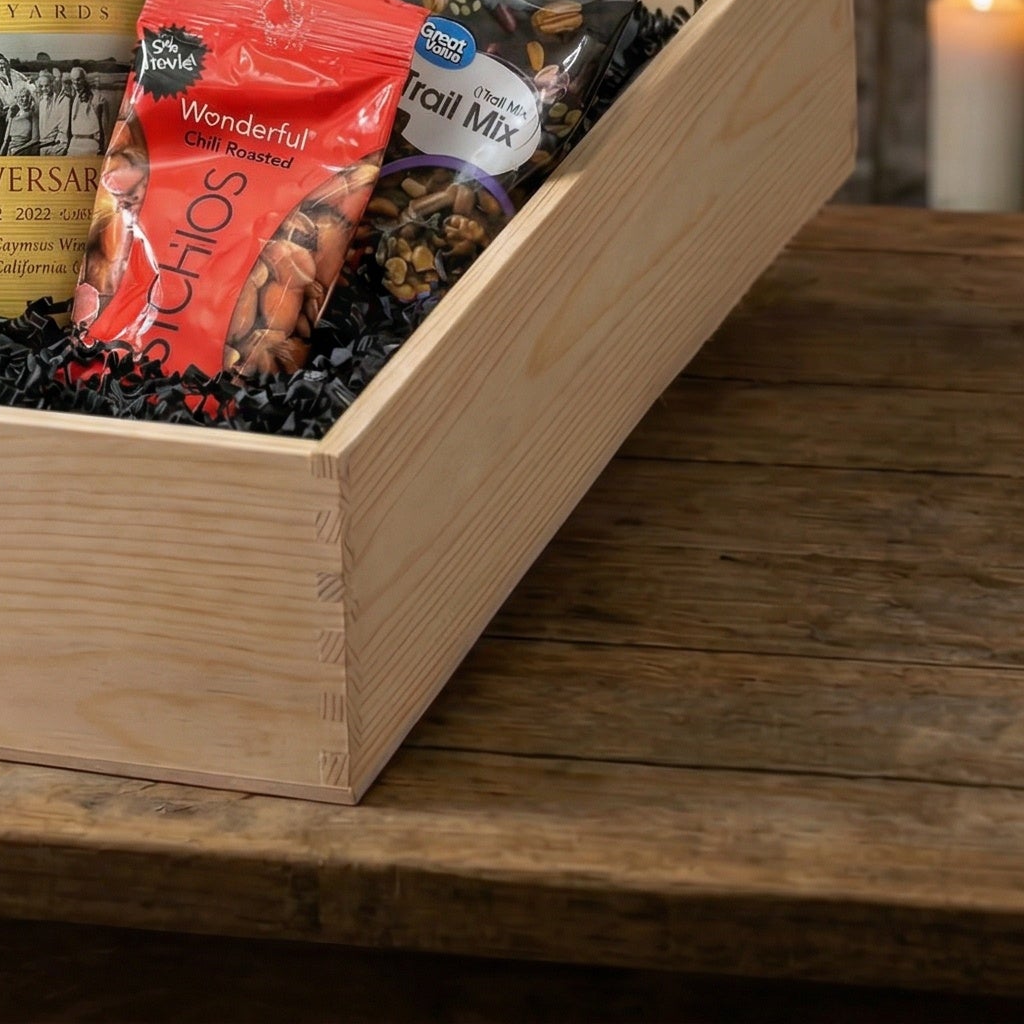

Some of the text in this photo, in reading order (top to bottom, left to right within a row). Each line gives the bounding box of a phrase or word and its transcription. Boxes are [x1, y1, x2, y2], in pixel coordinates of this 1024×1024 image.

[420, 21, 468, 54] Great
[181, 97, 309, 151] Wonderful
[402, 68, 520, 148] Trail Mix
[184, 130, 295, 169] Chili Roasted
[15, 207, 52, 222] 2022
